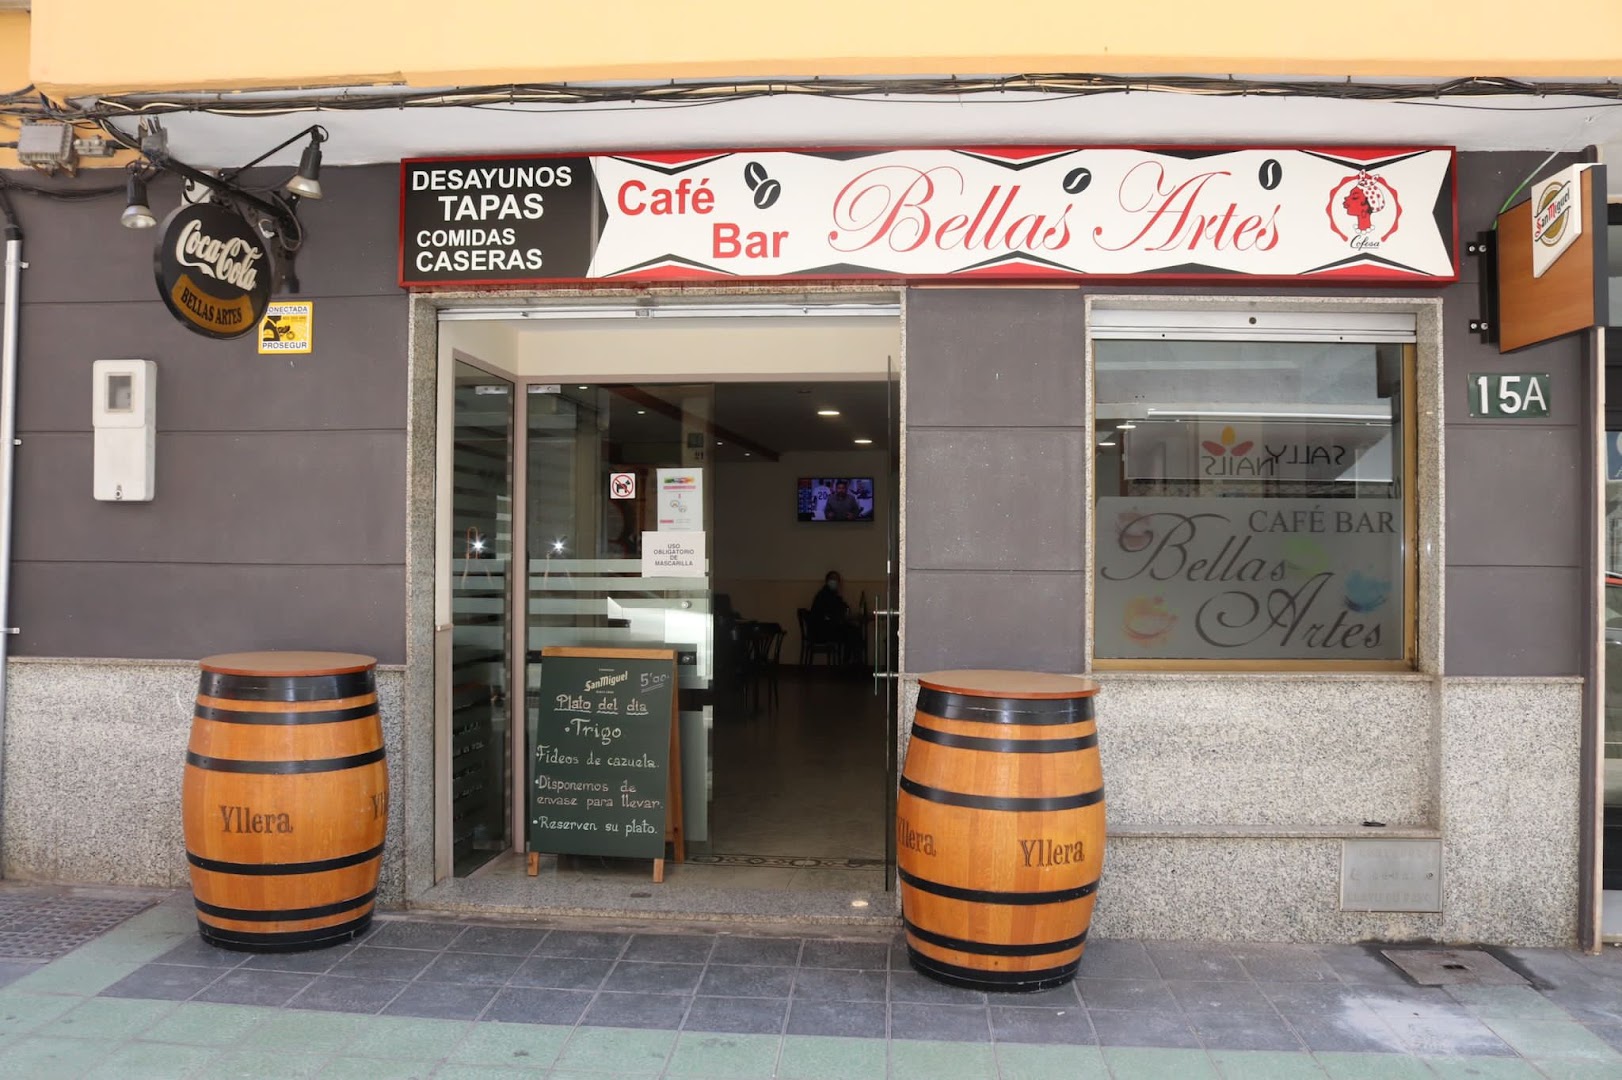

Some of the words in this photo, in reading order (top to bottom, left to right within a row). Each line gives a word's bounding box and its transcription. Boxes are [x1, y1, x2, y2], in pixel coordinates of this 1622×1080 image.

[412, 165, 572, 192] DESAYUNOS
[438, 193, 545, 222] TAPAS
[617, 177, 715, 216] Café
[828, 165, 1073, 252] Bellas
[1092, 160, 1280, 252] Artes
[416, 228, 516, 248] COMIDAS
[712, 222, 789, 259] Bar
[416, 248, 543, 272] CASERAS
[181, 287, 214, 322] BELLAS
[215, 307, 242, 326] ARTES
[262, 341, 307, 349] PROSEGUR
[1249, 505, 1326, 534] CAFÉ
[1335, 510, 1396, 533] BAR
[1100, 512, 1287, 582] Bellas
[1195, 572, 1383, 648] Artes
[556, 694, 591, 710] Plato
[598, 697, 618, 711] del
[569, 718, 622, 745] Trigo
[538, 745, 579, 764] Fideos
[586, 752, 601, 766] de
[538, 775, 609, 793] Disponemos
[620, 779, 637, 793] de
[537, 796, 578, 806] envase
[586, 797, 613, 810] para
[218, 805, 293, 834] Yllera
[540, 815, 597, 832] Reserven
[605, 823, 618, 832] su
[1018, 838, 1085, 868] Yllera
